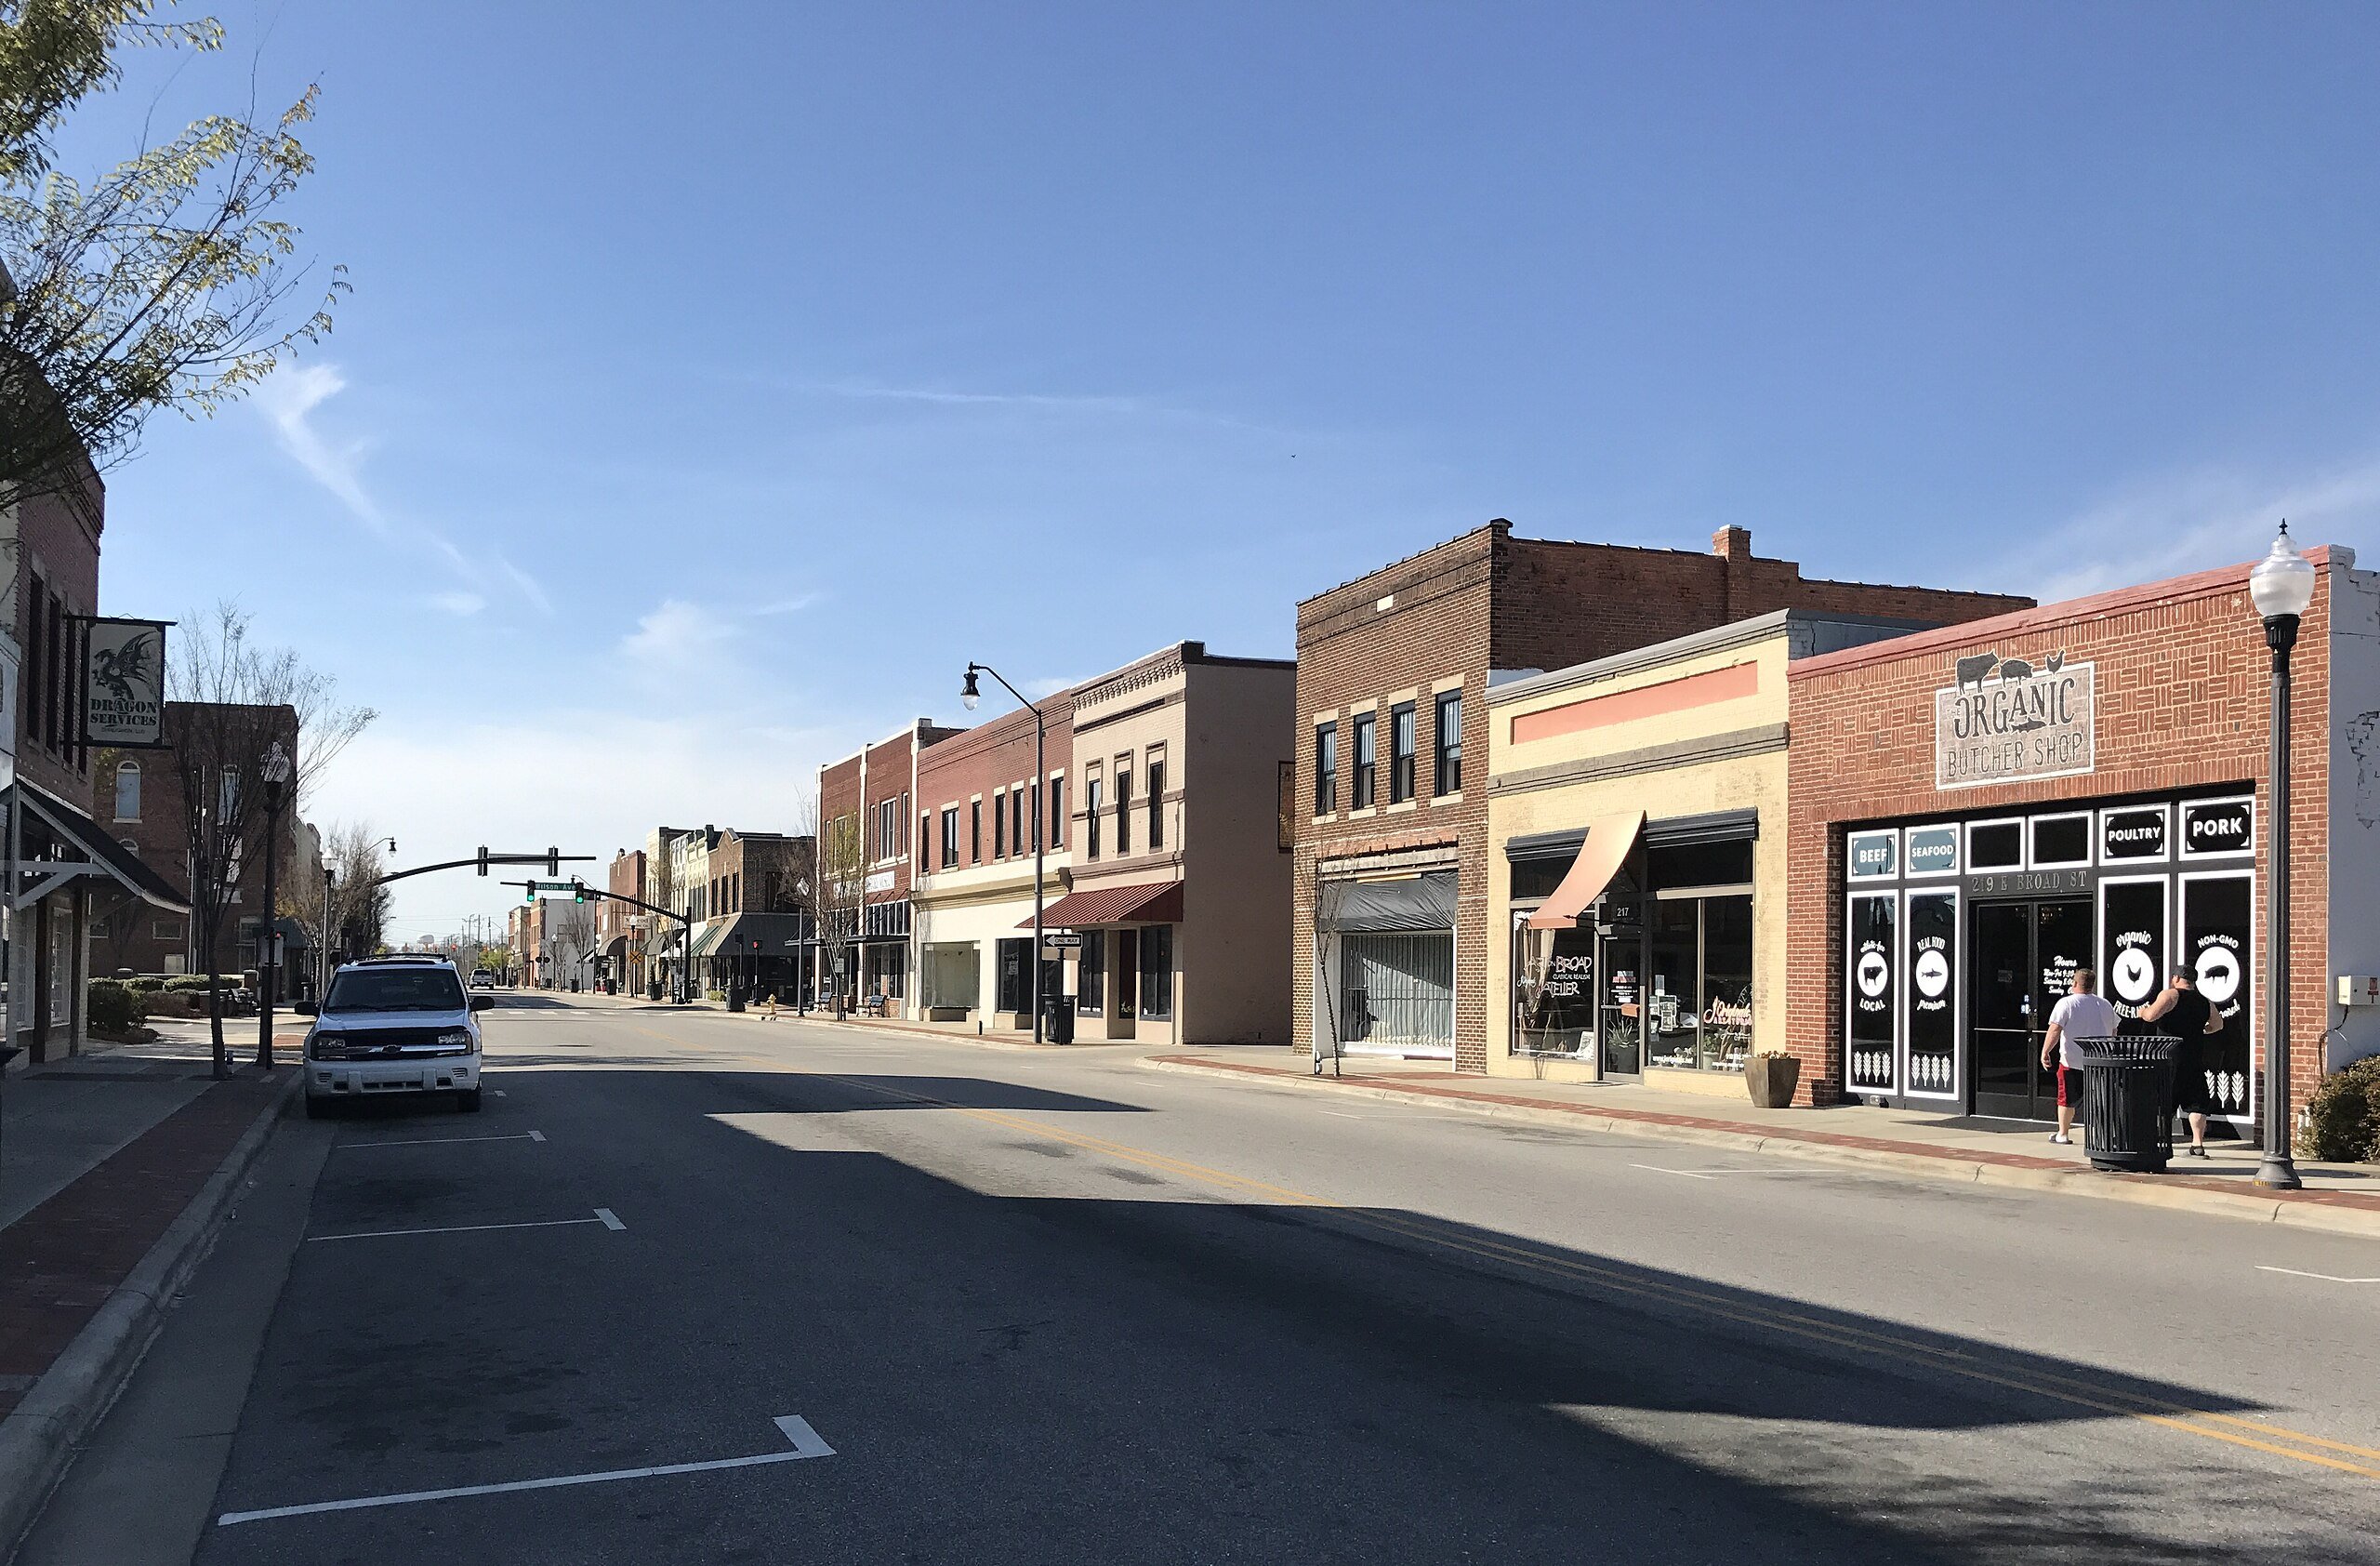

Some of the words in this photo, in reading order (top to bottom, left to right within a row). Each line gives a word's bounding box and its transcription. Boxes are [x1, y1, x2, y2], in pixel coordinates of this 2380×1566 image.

[90, 698, 157, 714] DRAGON
[1953, 677, 2075, 739] ORGANIC
[90, 713, 157, 725] SERVICES
[1948, 741, 2024, 777] BUTCHER
[2035, 733, 2083, 765] SHOP
[2192, 816, 2242, 837] PORK
[2108, 827, 2162, 842] POULTRY
[1859, 848, 1888, 863] BEEF
[1911, 844, 1954, 858] SEAFOOD
[1971, 876, 1994, 892] 219
[2001, 875, 2007, 890] E
[2016, 873, 2060, 890] BROAD
[2069, 870, 2086, 887] ST
[1617, 907, 1630, 917] 217
[1916, 936, 1932, 953] REAL
[1931, 936, 1946, 950] FOOD
[2116, 930, 2152, 949] organic
[2197, 935, 2240, 949] NON-GMO
[1555, 955, 1593, 974] BROAD
[2053, 955, 2078, 967] Hours
[2043, 977, 2063, 987] Saturday
[1535, 981, 1580, 999] ATELIER
[2048, 986, 2065, 996] Sunday
[1859, 997, 1885, 1012] LOCAL
[1916, 999, 1946, 1012] premium
[2113, 1000, 2150, 1019] FREE-R
